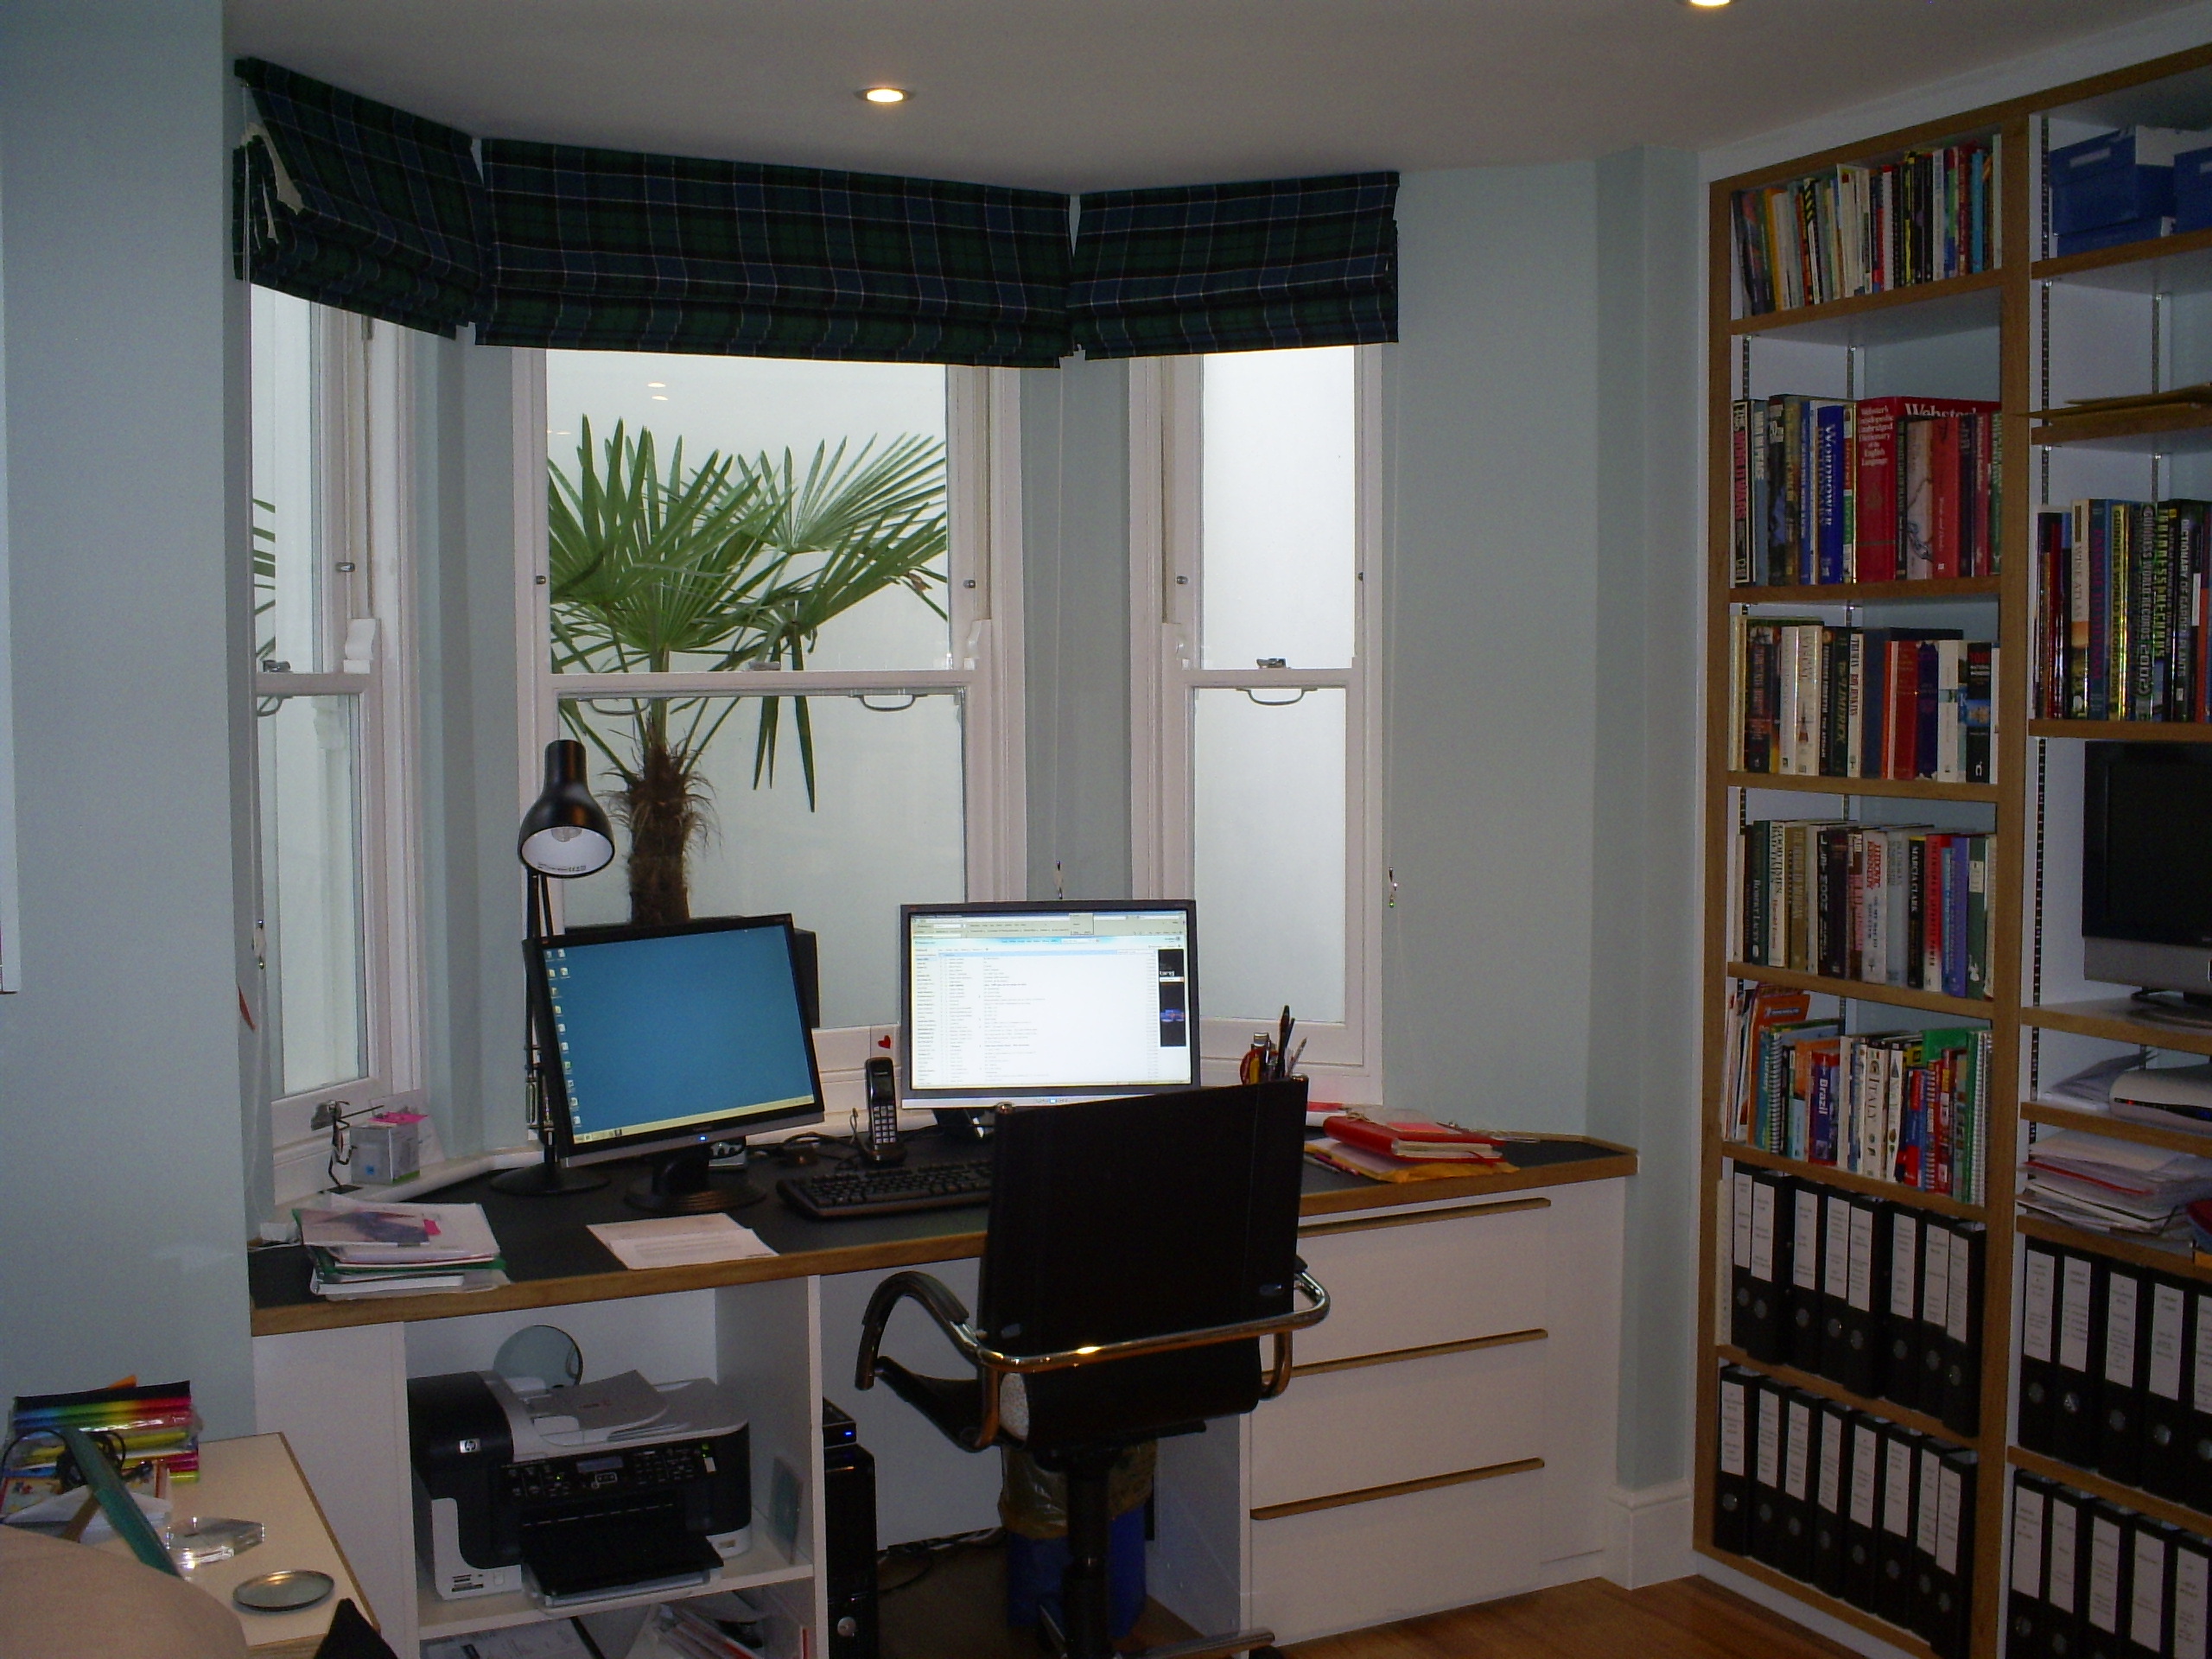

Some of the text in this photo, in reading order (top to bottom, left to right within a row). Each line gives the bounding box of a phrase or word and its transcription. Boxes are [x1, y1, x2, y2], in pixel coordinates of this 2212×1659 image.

[2180, 518, 2190, 578] DICTIONARY
[1819, 1077, 1828, 1116] Brazil
[1867, 1077, 1879, 1122] ITALY
